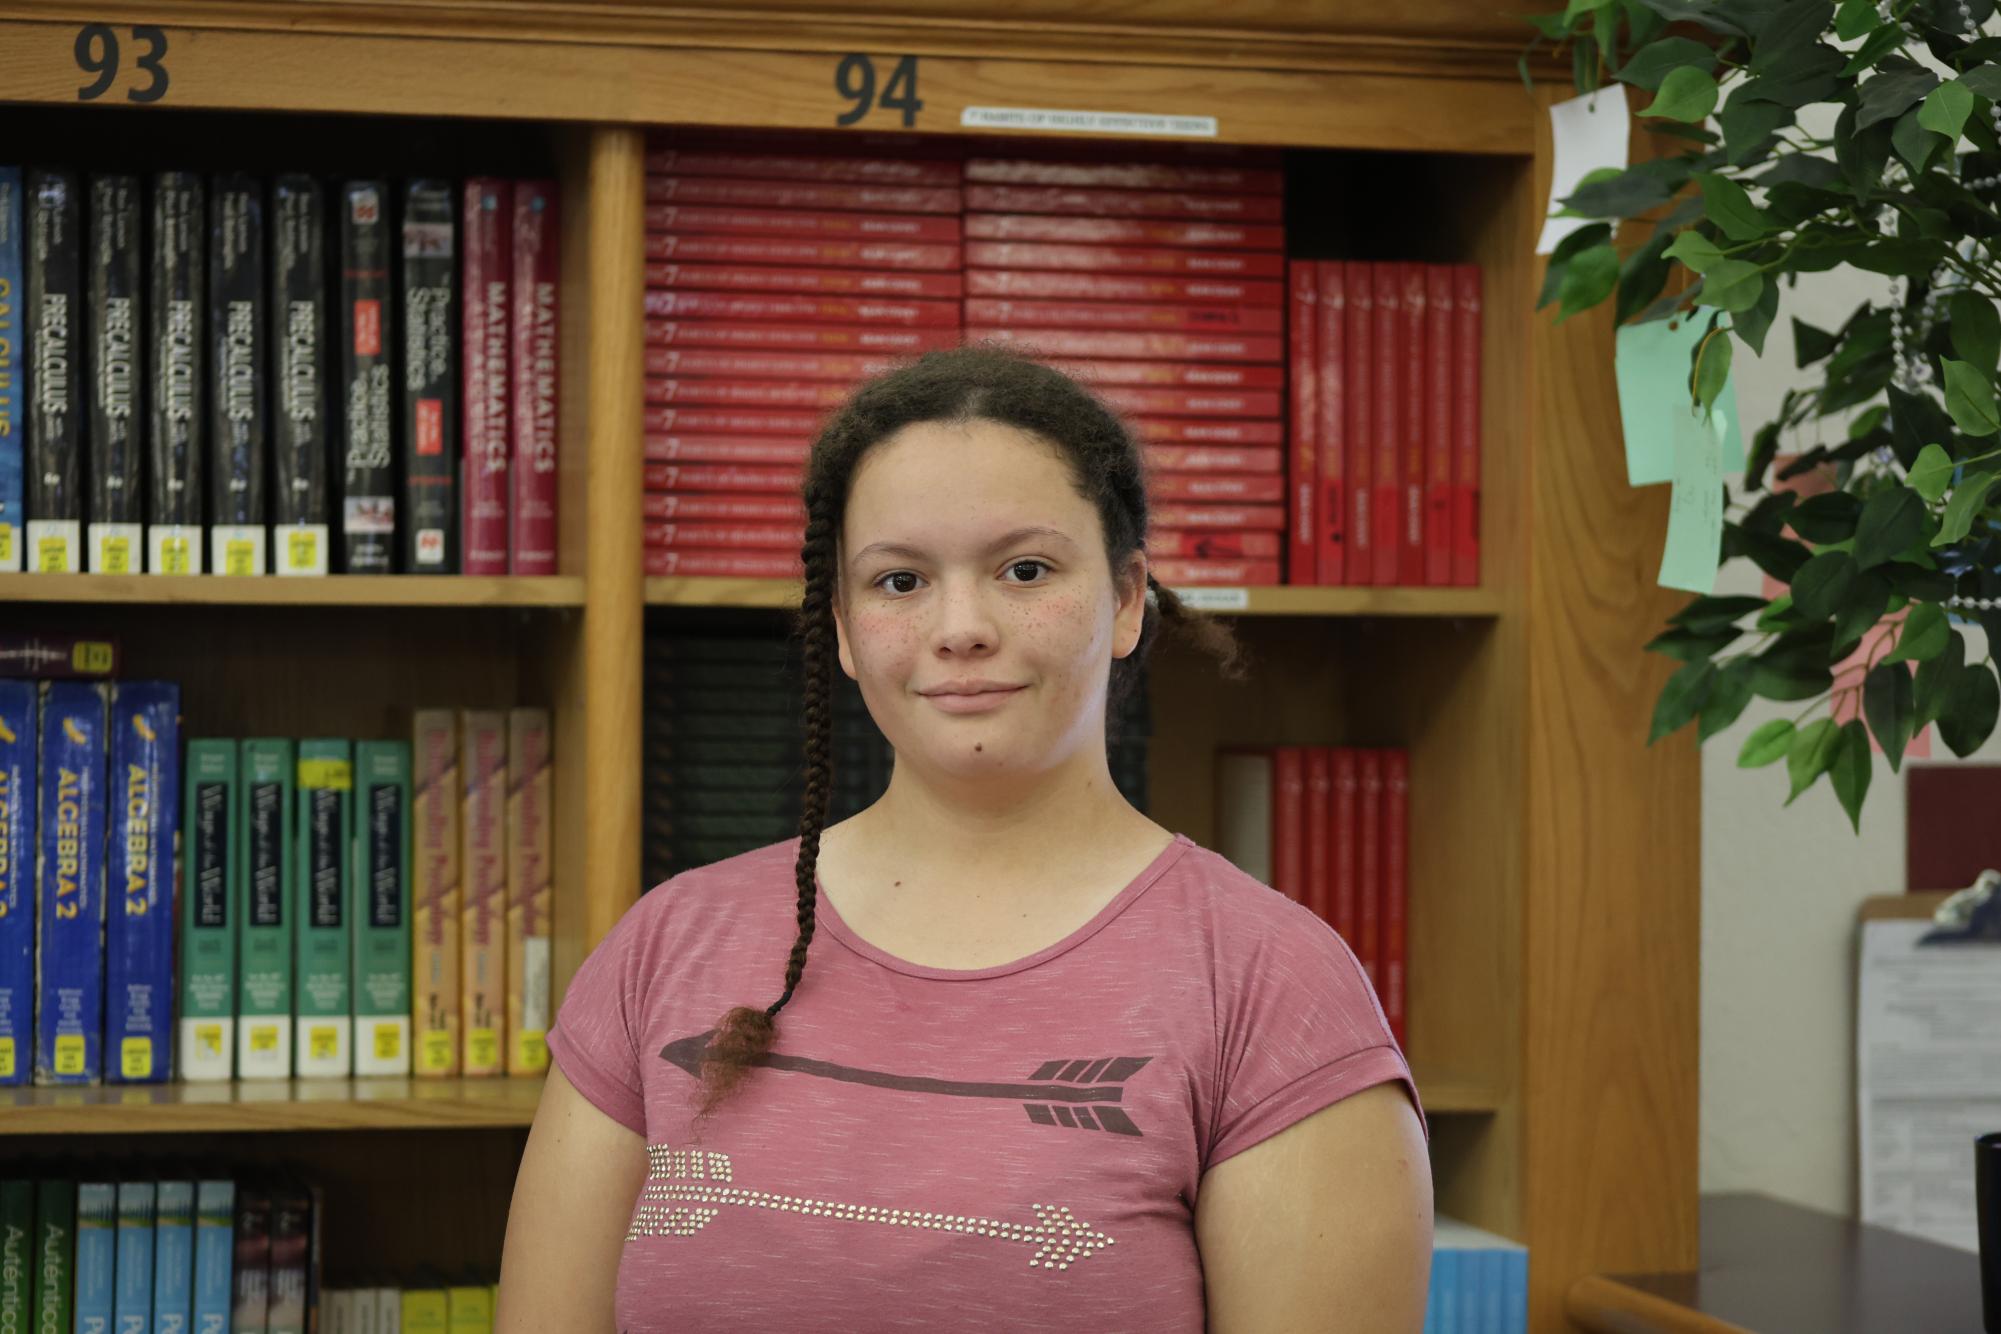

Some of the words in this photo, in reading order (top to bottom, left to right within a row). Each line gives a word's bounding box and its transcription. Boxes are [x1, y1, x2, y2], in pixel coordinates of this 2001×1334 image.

[74, 24, 170, 102] 93
[835, 53, 924, 127] 94
[42, 293, 67, 413] PRECALCULUS
[106, 297, 130, 418] PRECALCULUS
[167, 301, 192, 420] PRECALCULUS
[228, 301, 253, 420] PRECALCULUS
[289, 301, 315, 420] PRECALCULUS
[486, 281, 506, 472] MATHEMATICS
[534, 282, 555, 473] MATHEMATICS
[57, 767, 79, 896] ALGEBRA
[127, 764, 149, 894] ALGEBRA
[56, 902, 78, 919] 2
[126, 898, 148, 916] 2
[518, 854, 544, 937] Psycholog
